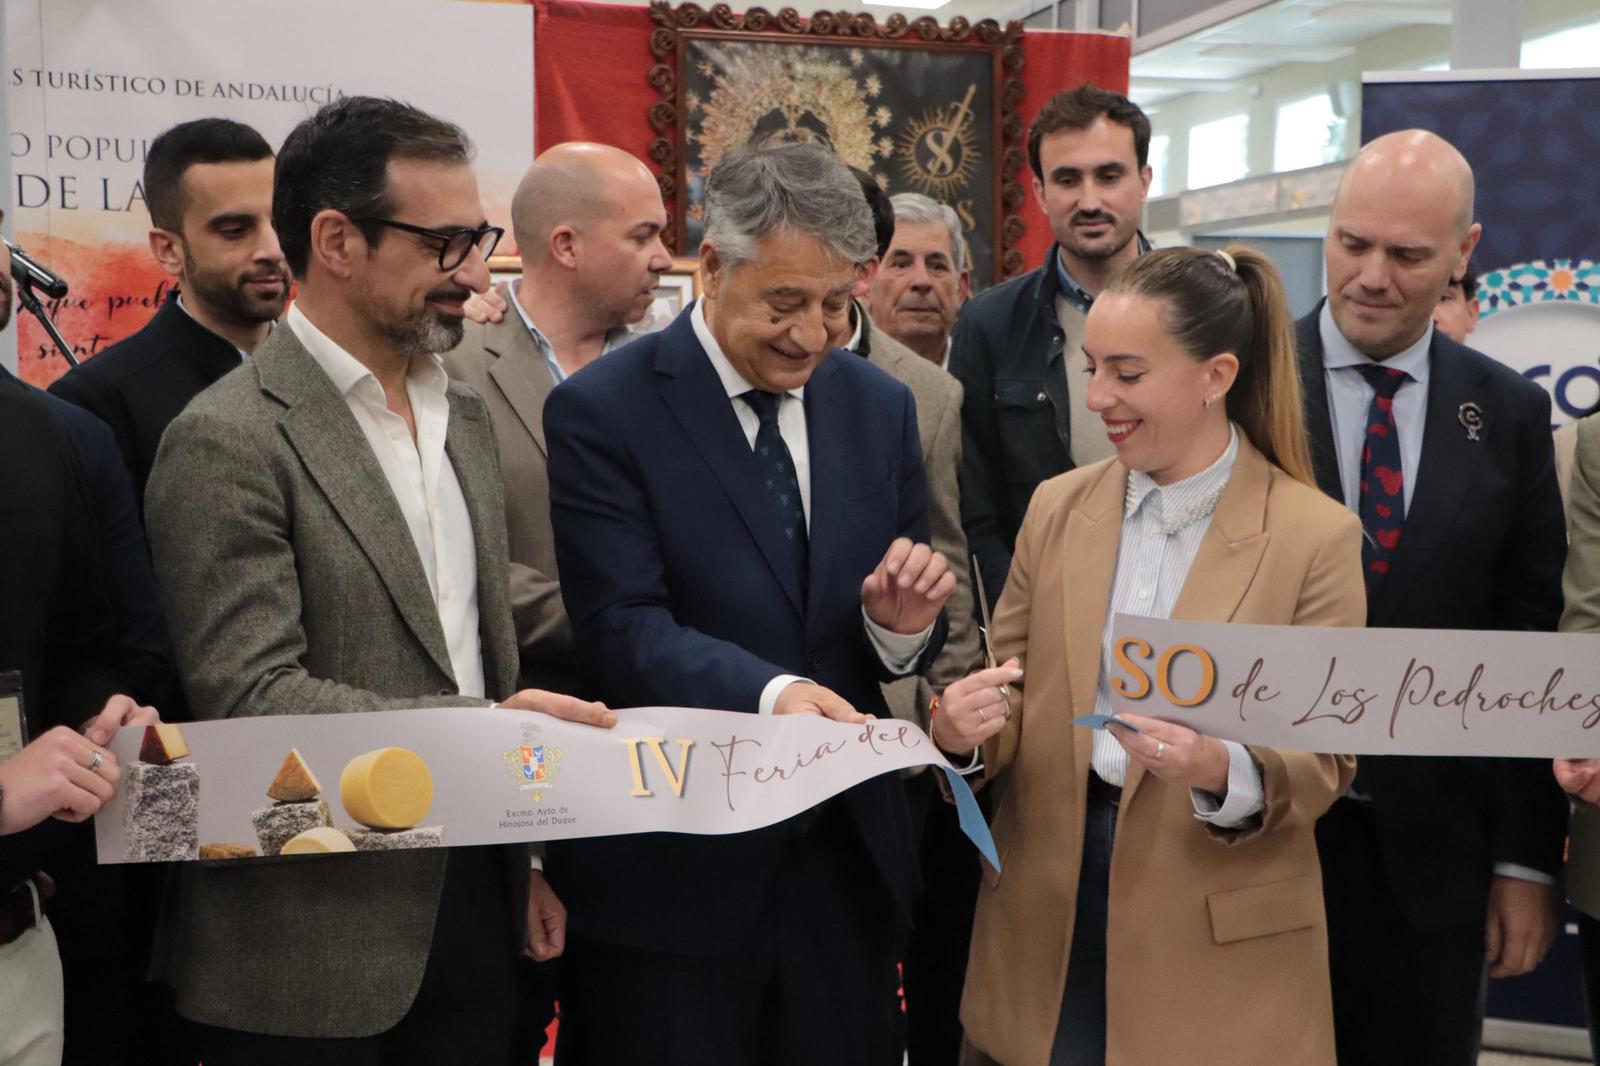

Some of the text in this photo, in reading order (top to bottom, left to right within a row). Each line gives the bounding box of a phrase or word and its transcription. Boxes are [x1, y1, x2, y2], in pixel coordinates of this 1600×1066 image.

[30, 69, 166, 96] TURÍSTICO
[175, 79, 205, 97] DE
[211, 82, 346, 104] ANDALUCÍA
[17, 173, 79, 209] DE
[1110, 636, 1600, 740] SO de Los Pedroches
[621, 724, 921, 812] IV Feria del
[499, 816, 577, 830] Hinojosa del Duque
[536, 807, 557, 817] Ayto
[558, 806, 569, 815] de
